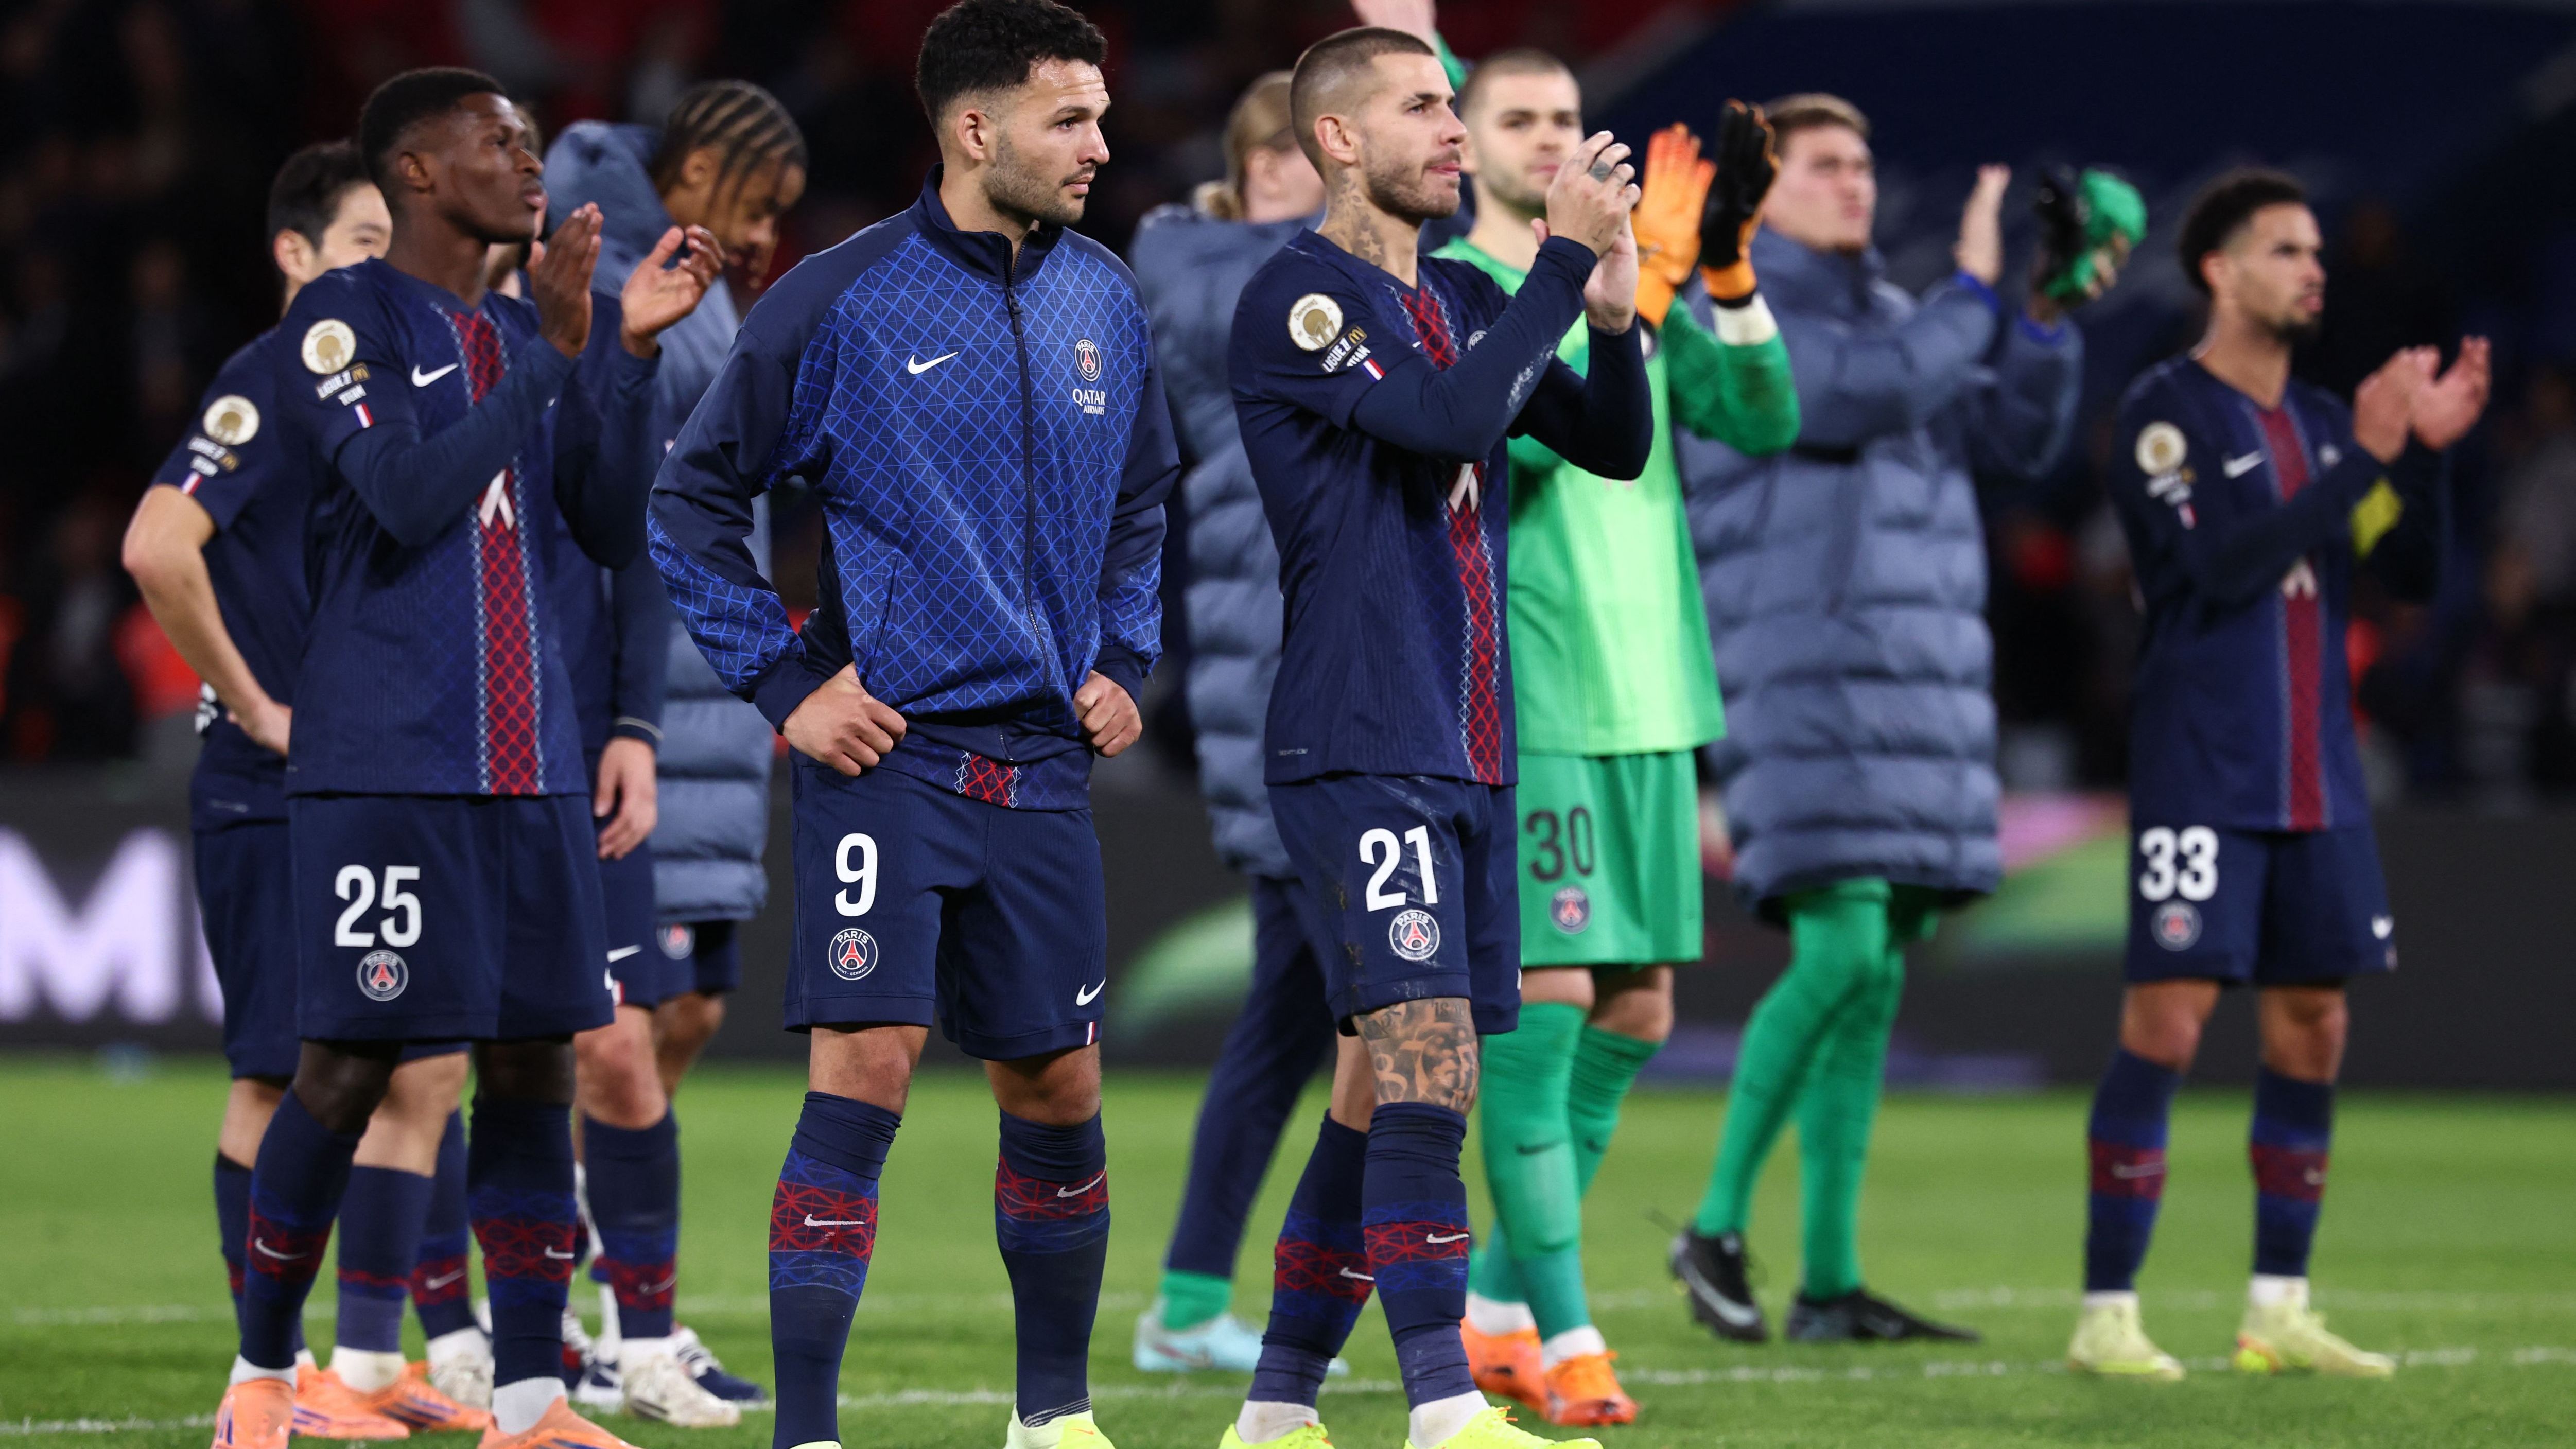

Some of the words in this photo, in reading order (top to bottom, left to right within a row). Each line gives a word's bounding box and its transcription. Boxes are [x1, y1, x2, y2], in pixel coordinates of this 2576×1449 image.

[1077, 342, 1095, 352] PARIS
[1072, 388, 1105, 407] QATAR
[1083, 404, 1105, 415] AIRWAYS
[1525, 806, 1594, 883] 30
[1359, 825, 1438, 912] 21
[2138, 825, 2219, 902] 33
[835, 833, 878, 917] 9
[335, 865, 422, 947] 25
[1396, 912, 1430, 926] PARIS
[837, 931, 869, 944] PARIS
[836, 965, 847, 975] SAINT
[850, 966, 868, 976] GERMAIN
